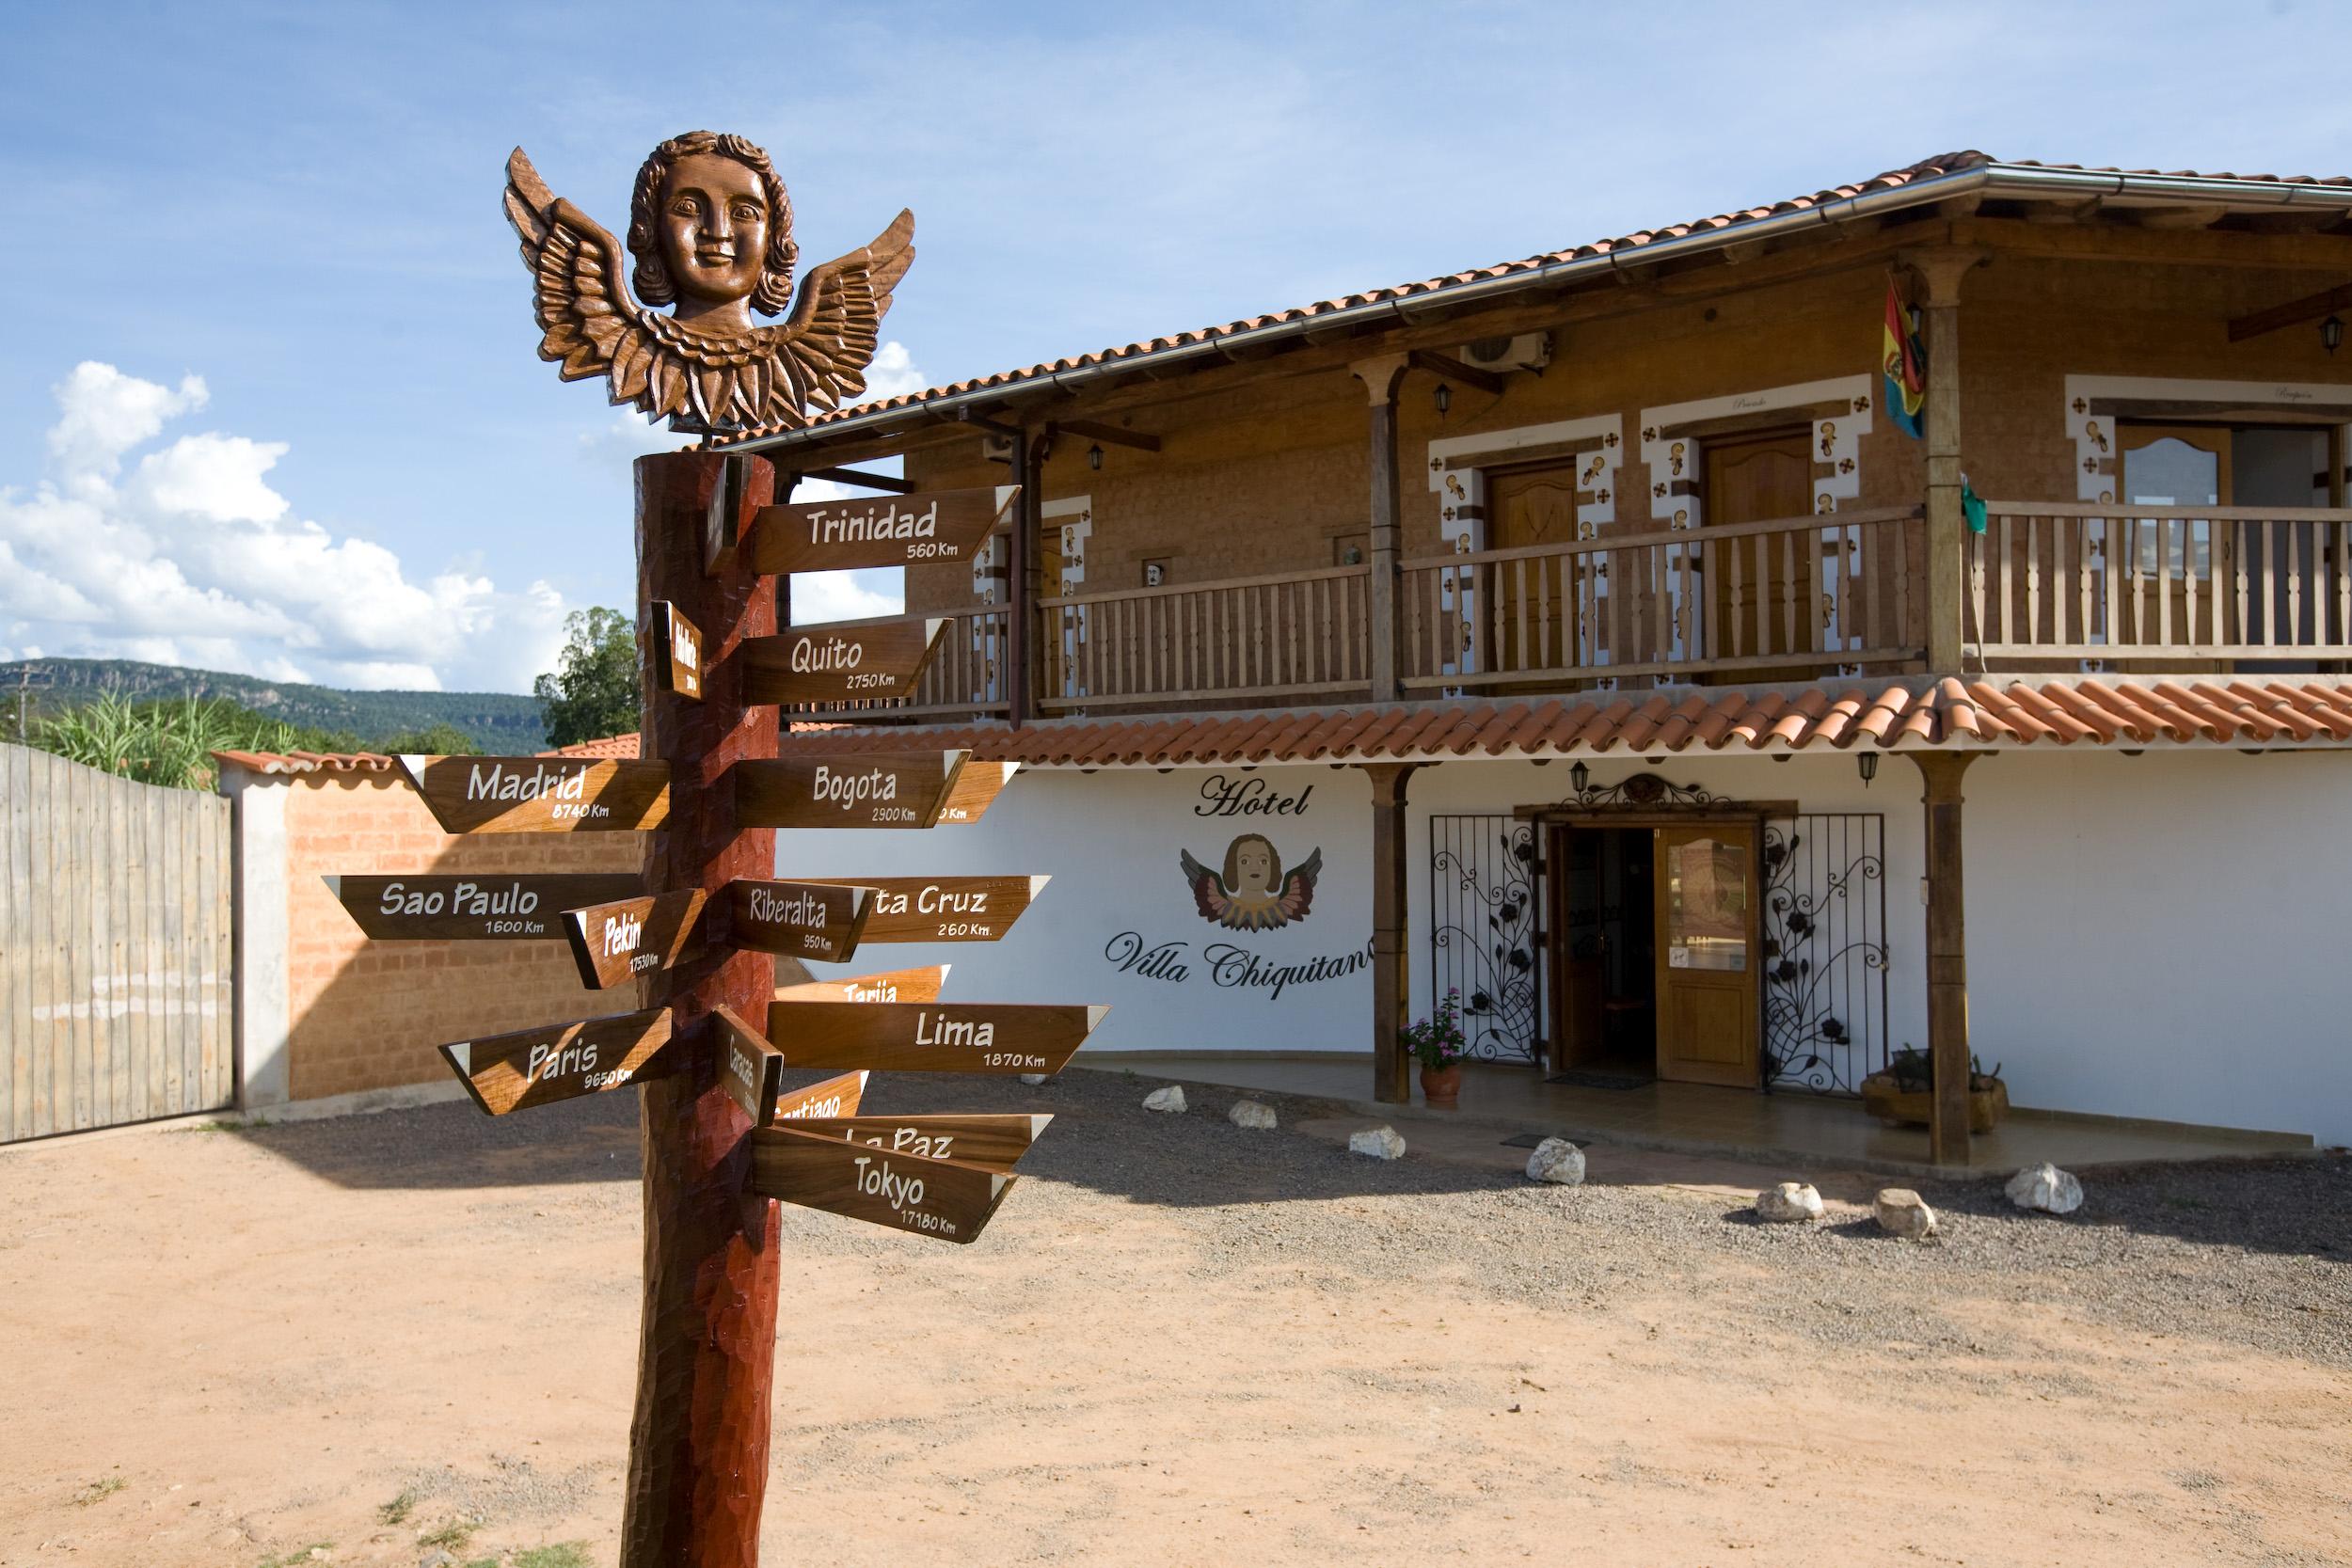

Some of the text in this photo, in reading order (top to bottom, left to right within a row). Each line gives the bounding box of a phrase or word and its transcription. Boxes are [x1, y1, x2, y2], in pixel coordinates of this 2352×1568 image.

[806, 500, 937, 545] Trinidad
[907, 543, 937, 559] 560
[791, 637, 863, 673] Quito
[847, 674, 878, 689] 2750
[467, 763, 587, 800] Madrid
[813, 765, 897, 811] Bogota
[1194, 774, 1314, 817] Hotel
[552, 803, 590, 818] 8740
[871, 807, 900, 822] 2900
[379, 881, 538, 916] Sao Paulo
[750, 888, 826, 928] Riberalta
[917, 885, 988, 913] Cruz
[485, 921, 523, 934] 1600
[604, 912, 642, 958] Pekin
[937, 923, 968, 936] 260
[1104, 931, 1190, 983] Villa
[915, 1012, 994, 1047] Lima
[527, 1037, 597, 1084] Paris
[983, 1053, 1023, 1067] 1870
[774, 1096, 840, 1118] ntiago
[893, 1128, 954, 1159] Paz
[854, 1156, 924, 1211] Tokyo
[900, 1210, 940, 1229] 17180
